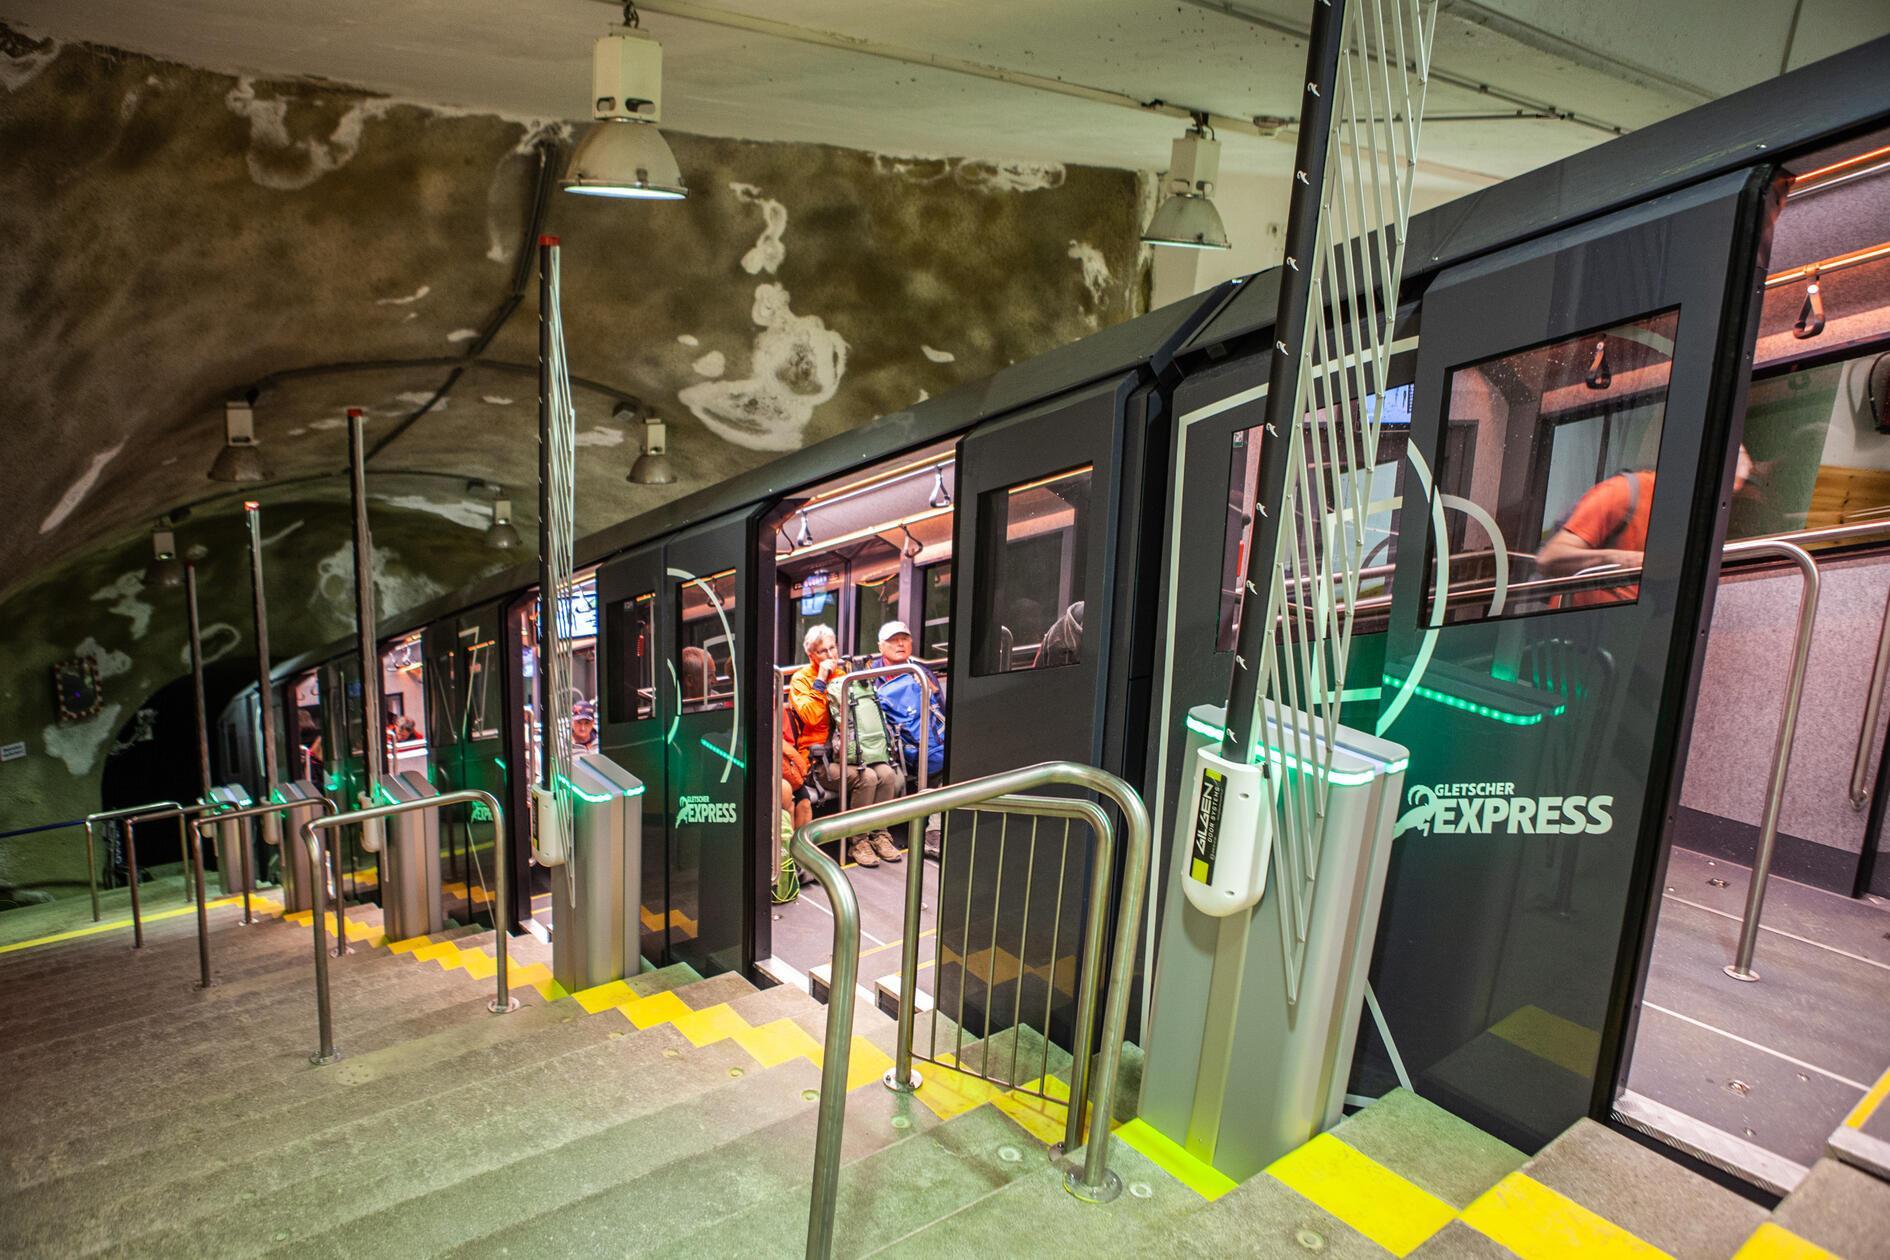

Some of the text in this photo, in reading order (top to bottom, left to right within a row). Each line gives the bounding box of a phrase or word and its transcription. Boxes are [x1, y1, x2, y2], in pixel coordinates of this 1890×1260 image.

[1434, 782, 1515, 796] GLETSCHER
[688, 803, 737, 823] EXPRESS
[1196, 782, 1214, 855] GILGEN
[1207, 822, 1215, 843] DOOR
[1211, 786, 1221, 821] SYSTEMS
[1433, 795, 1614, 835] EXPRESS
